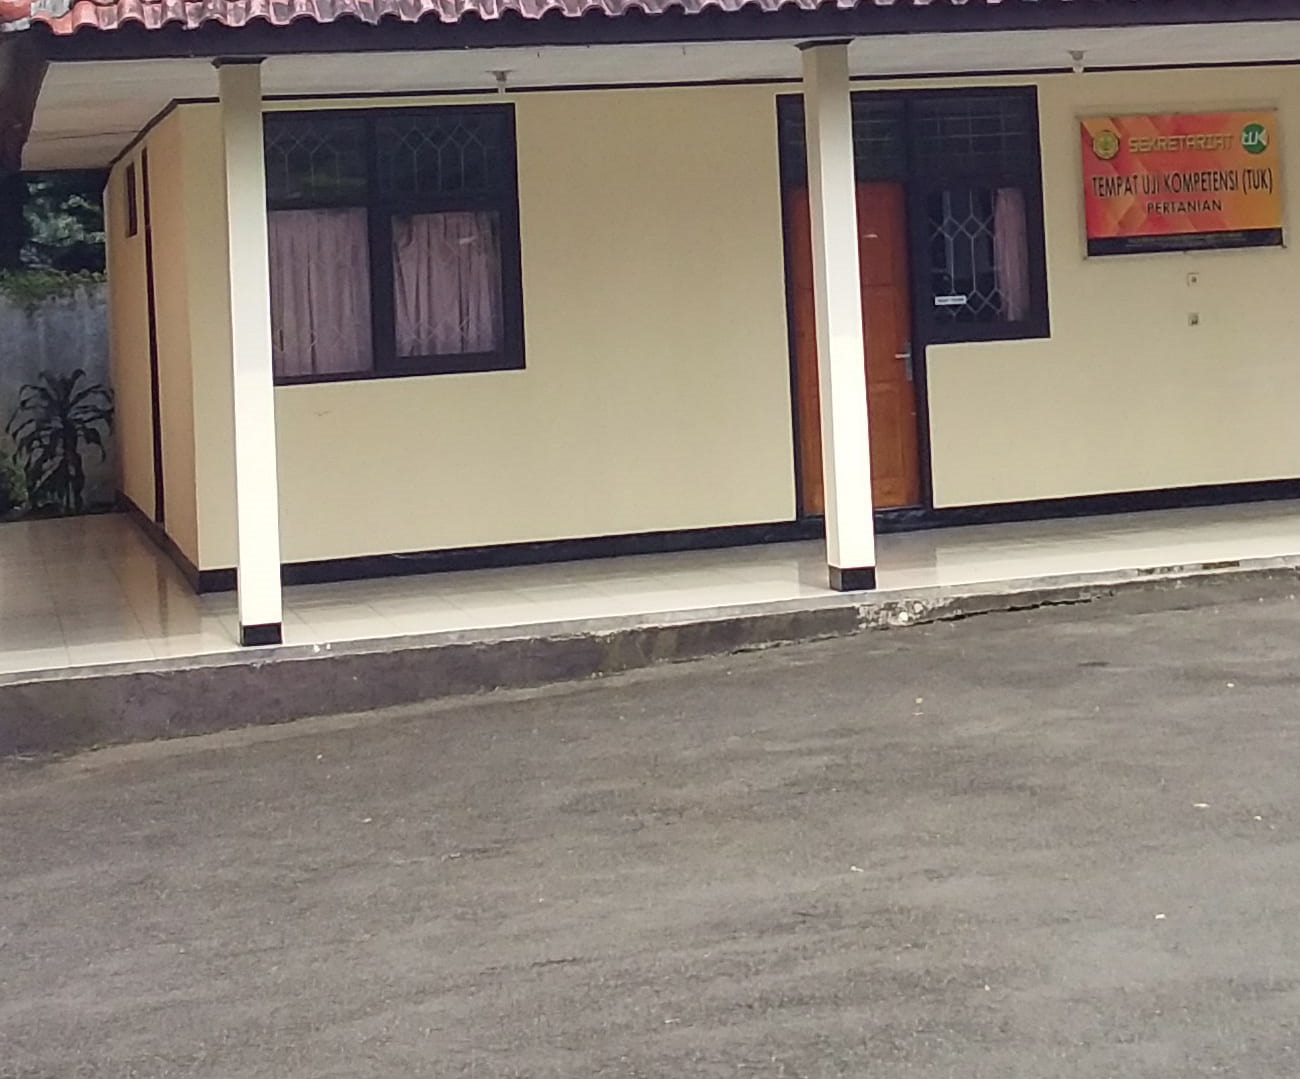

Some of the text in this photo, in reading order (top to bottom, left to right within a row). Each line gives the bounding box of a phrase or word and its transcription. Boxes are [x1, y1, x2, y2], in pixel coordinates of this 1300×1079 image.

[1129, 133, 1233, 153] SEKRETARIAT
[1092, 167, 1273, 198] TEMPAT UJI KOMPETENSI (TUK)
[1147, 199, 1222, 215] PERTANIAN
